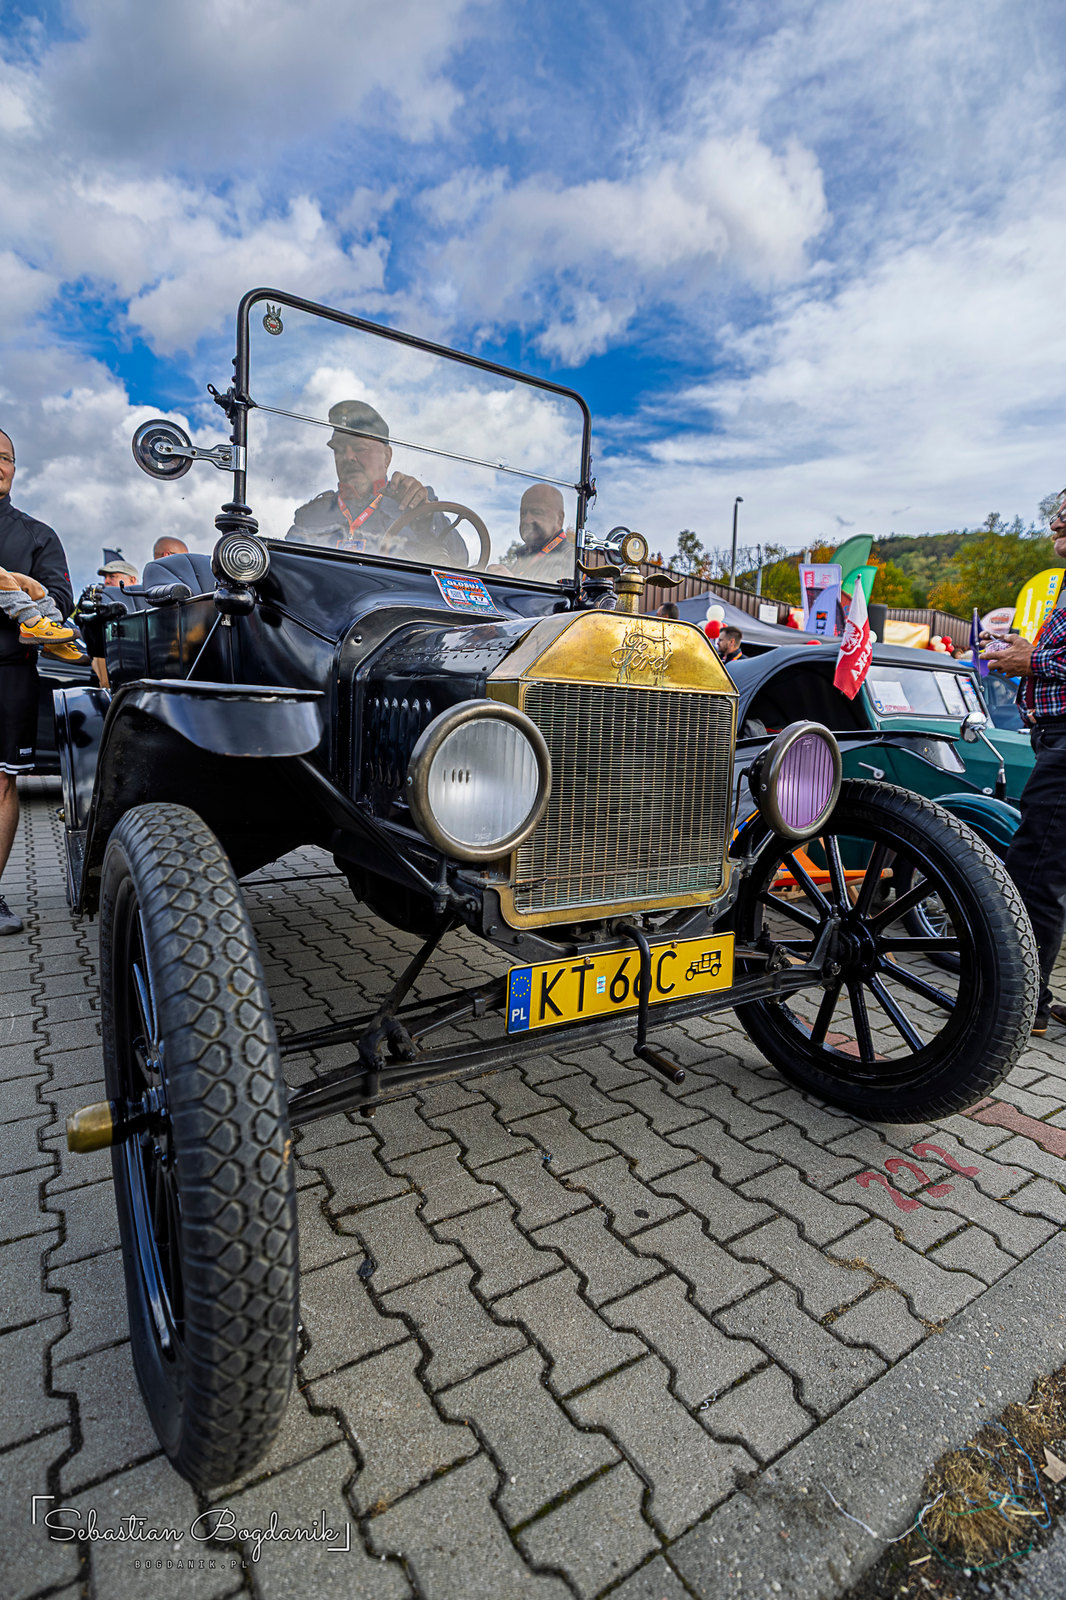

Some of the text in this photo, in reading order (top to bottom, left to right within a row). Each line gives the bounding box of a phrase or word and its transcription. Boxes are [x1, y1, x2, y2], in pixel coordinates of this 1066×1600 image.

[611, 632, 673, 671] Ford
[511, 1008, 527, 1023] PL
[539, 963, 595, 1020] KT
[855, 1142, 981, 1213] 222
